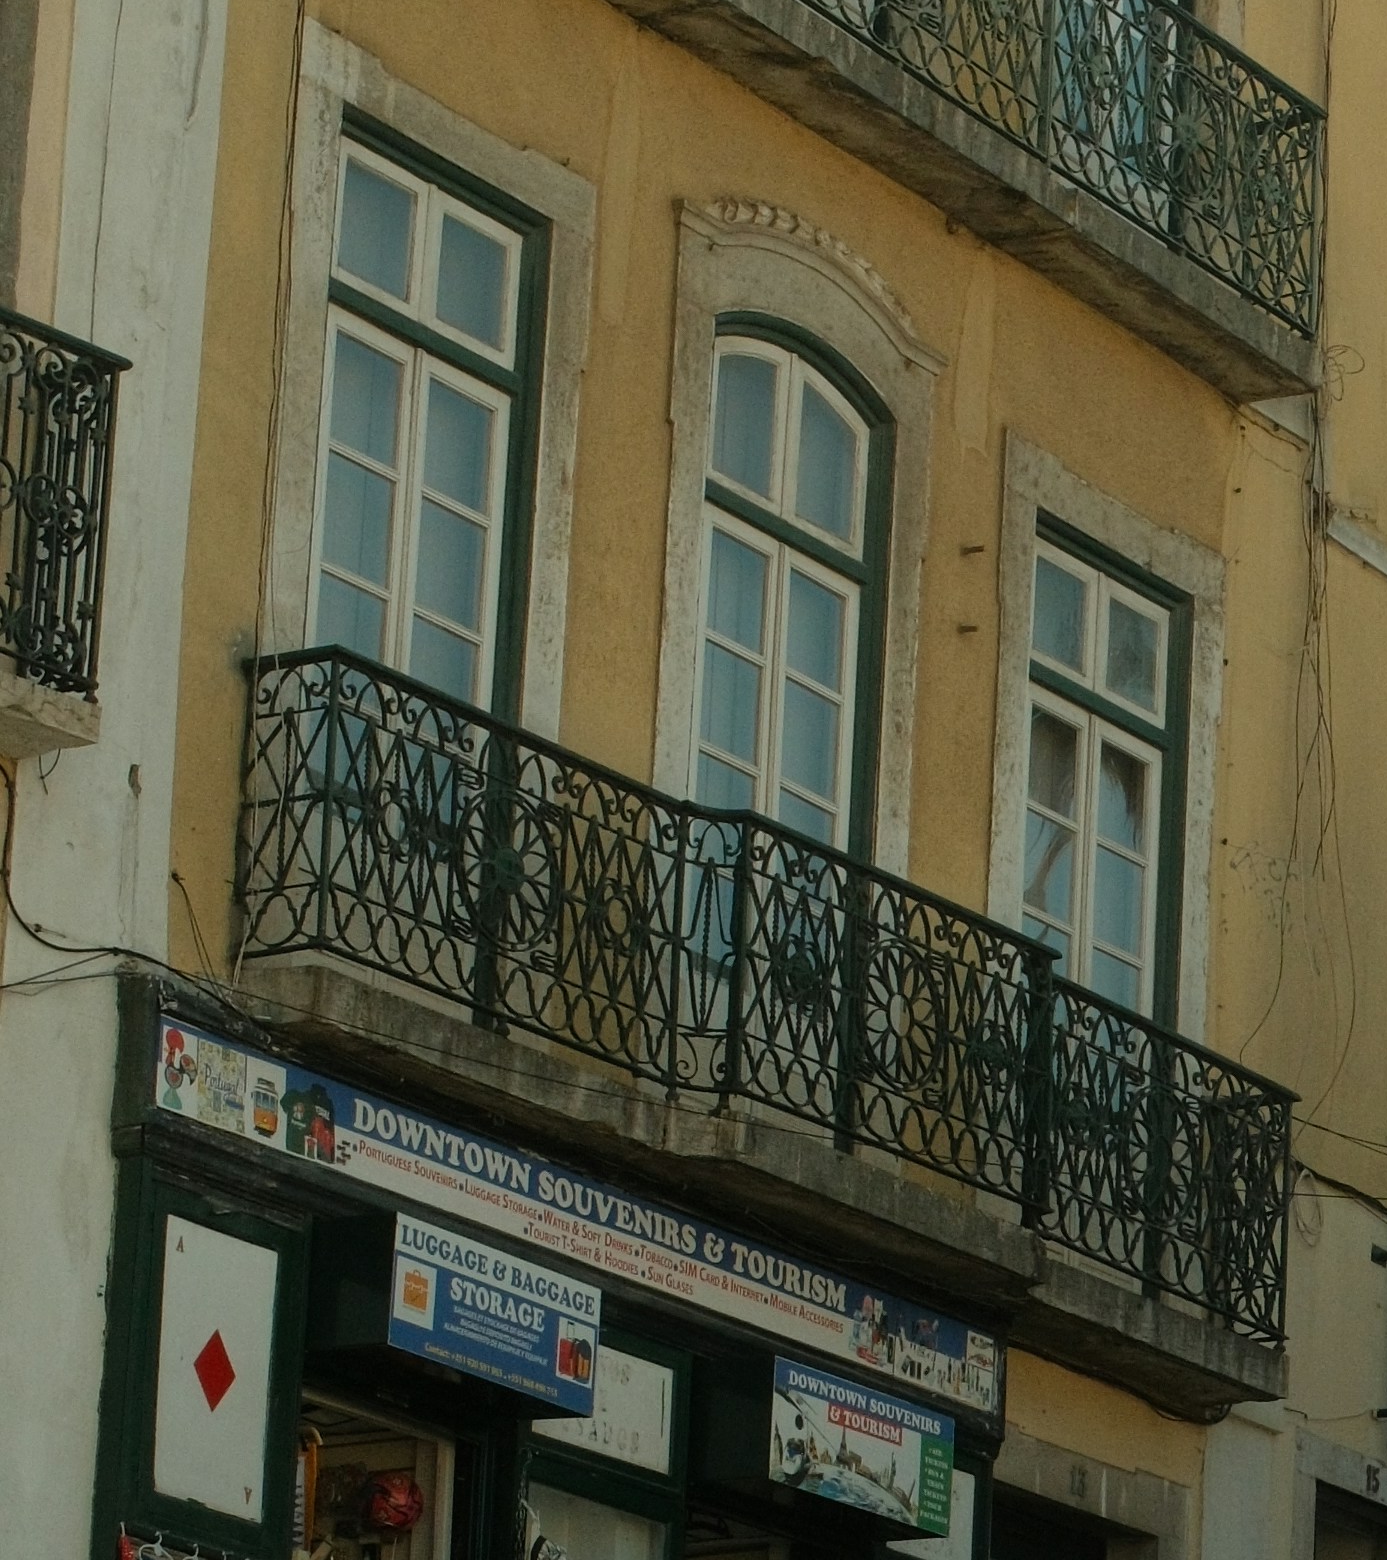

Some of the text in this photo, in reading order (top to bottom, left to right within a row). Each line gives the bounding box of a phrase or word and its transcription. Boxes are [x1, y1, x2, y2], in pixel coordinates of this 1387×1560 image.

[354, 1097, 847, 1312] DOWNTOWN SOUVENIRS & TOURISM
[174, 1233, 185, 1253] A
[358, 1139, 412, 1172] PORTUGUESE
[414, 1160, 458, 1190] SOUVENIRS
[464, 1178, 501, 1206] LUGGAGE
[502, 1194, 539, 1221] STORAGE
[571, 1221, 580, 1236] &
[582, 1225, 601, 1245] SOFT
[638, 1244, 673, 1270] TOBACCO
[678, 1258, 698, 1278] SIM
[699, 1267, 720, 1287] CARD
[721, 1274, 729, 1291] &
[769, 1293, 798, 1317] MOBILE
[798, 1304, 845, 1335] ACCESSORIES
[527, 1222, 560, 1247] TOURIST
[561, 1234, 592, 1259] T-SHIRT
[593, 1247, 602, 1263] &
[647, 1266, 664, 1283] SUN
[401, 1224, 596, 1317] LUGGAGE & BAGGAGE
[449, 1276, 546, 1333] STORAGE
[788, 1369, 942, 1436] DOWNTOWN SOUVENIRS
[829, 1406, 902, 1444] & TOURISM
[1366, 1464, 1380, 1494] 15
